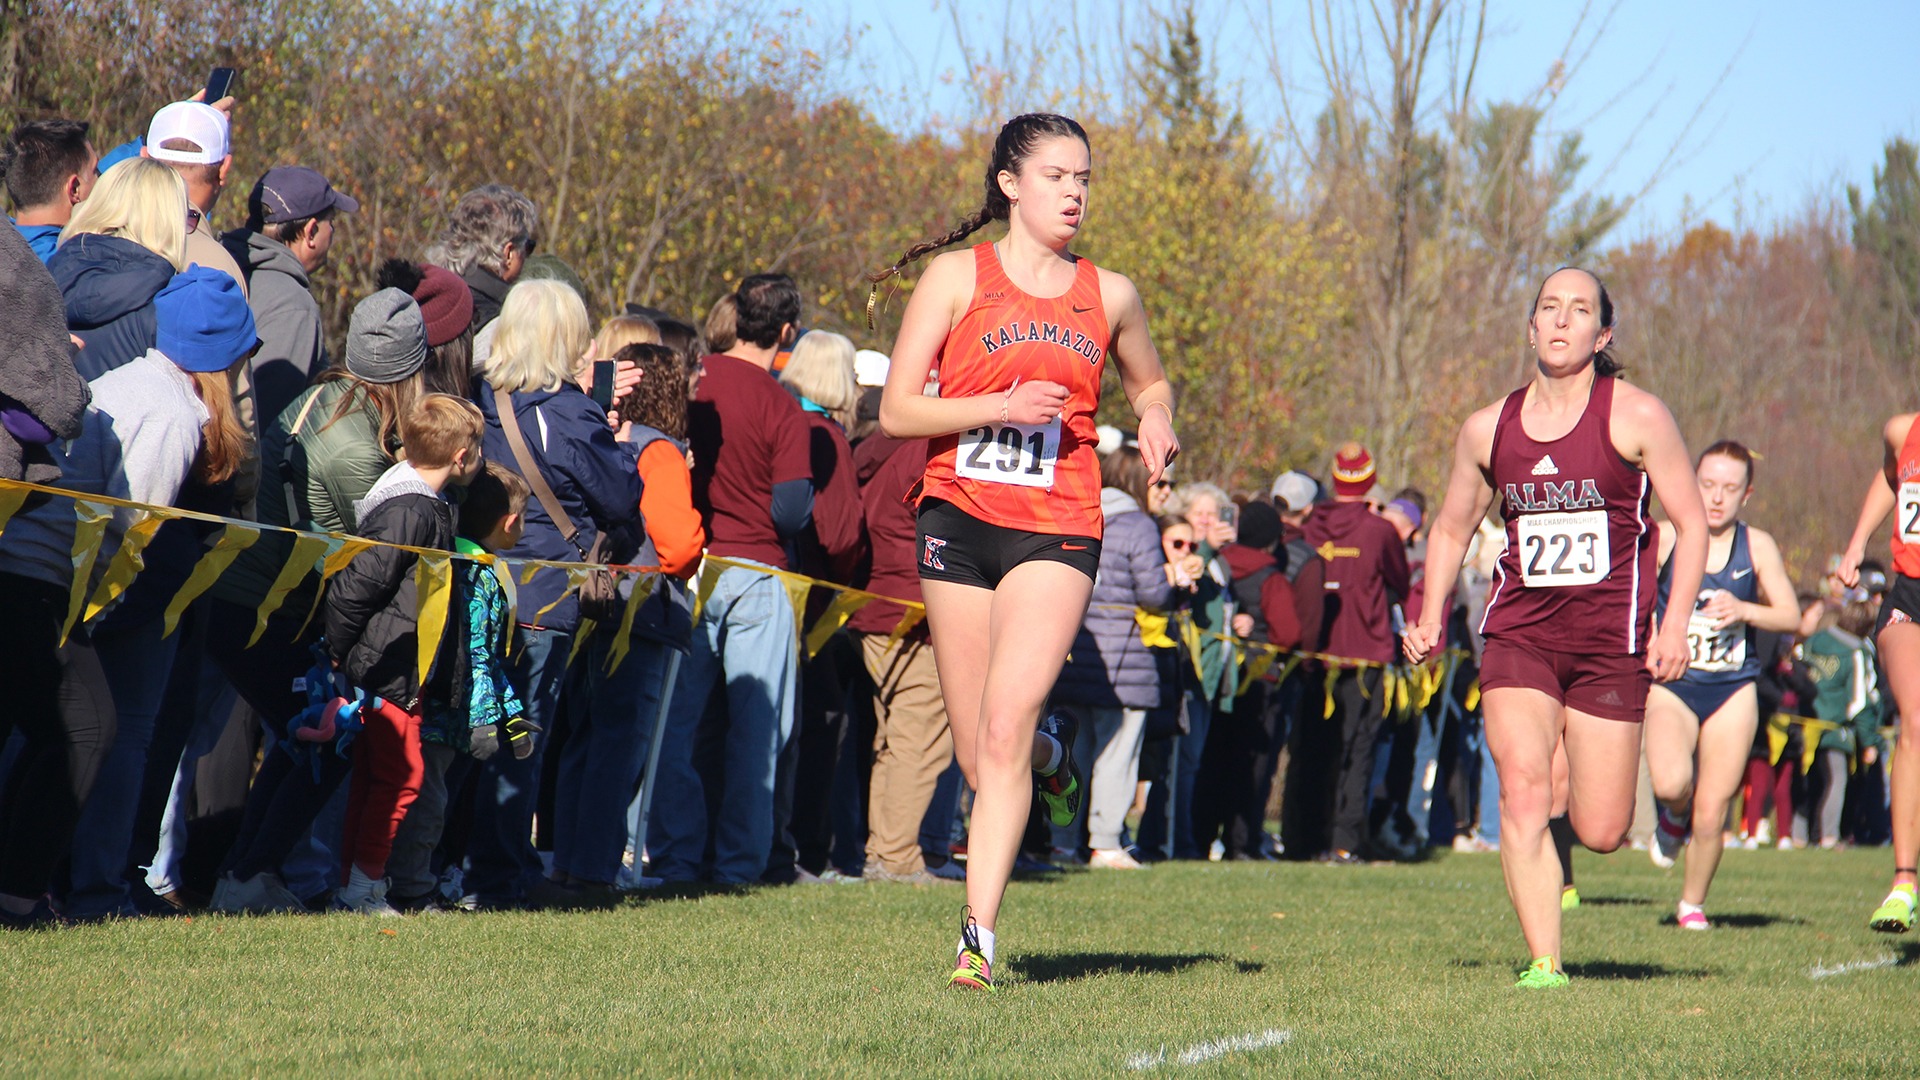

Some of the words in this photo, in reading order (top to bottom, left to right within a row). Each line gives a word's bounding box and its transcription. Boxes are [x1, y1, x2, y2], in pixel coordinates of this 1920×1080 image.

[984, 291, 1005, 300] MIAA
[981, 321, 1102, 366] KALAMAZOO
[965, 425, 1044, 476] 291
[1506, 479, 1605, 511] ALMA
[1527, 518, 1543, 527] MIAA
[1544, 516, 1598, 527] CHAMPIONSHIPS
[1526, 532, 1599, 577] 223
